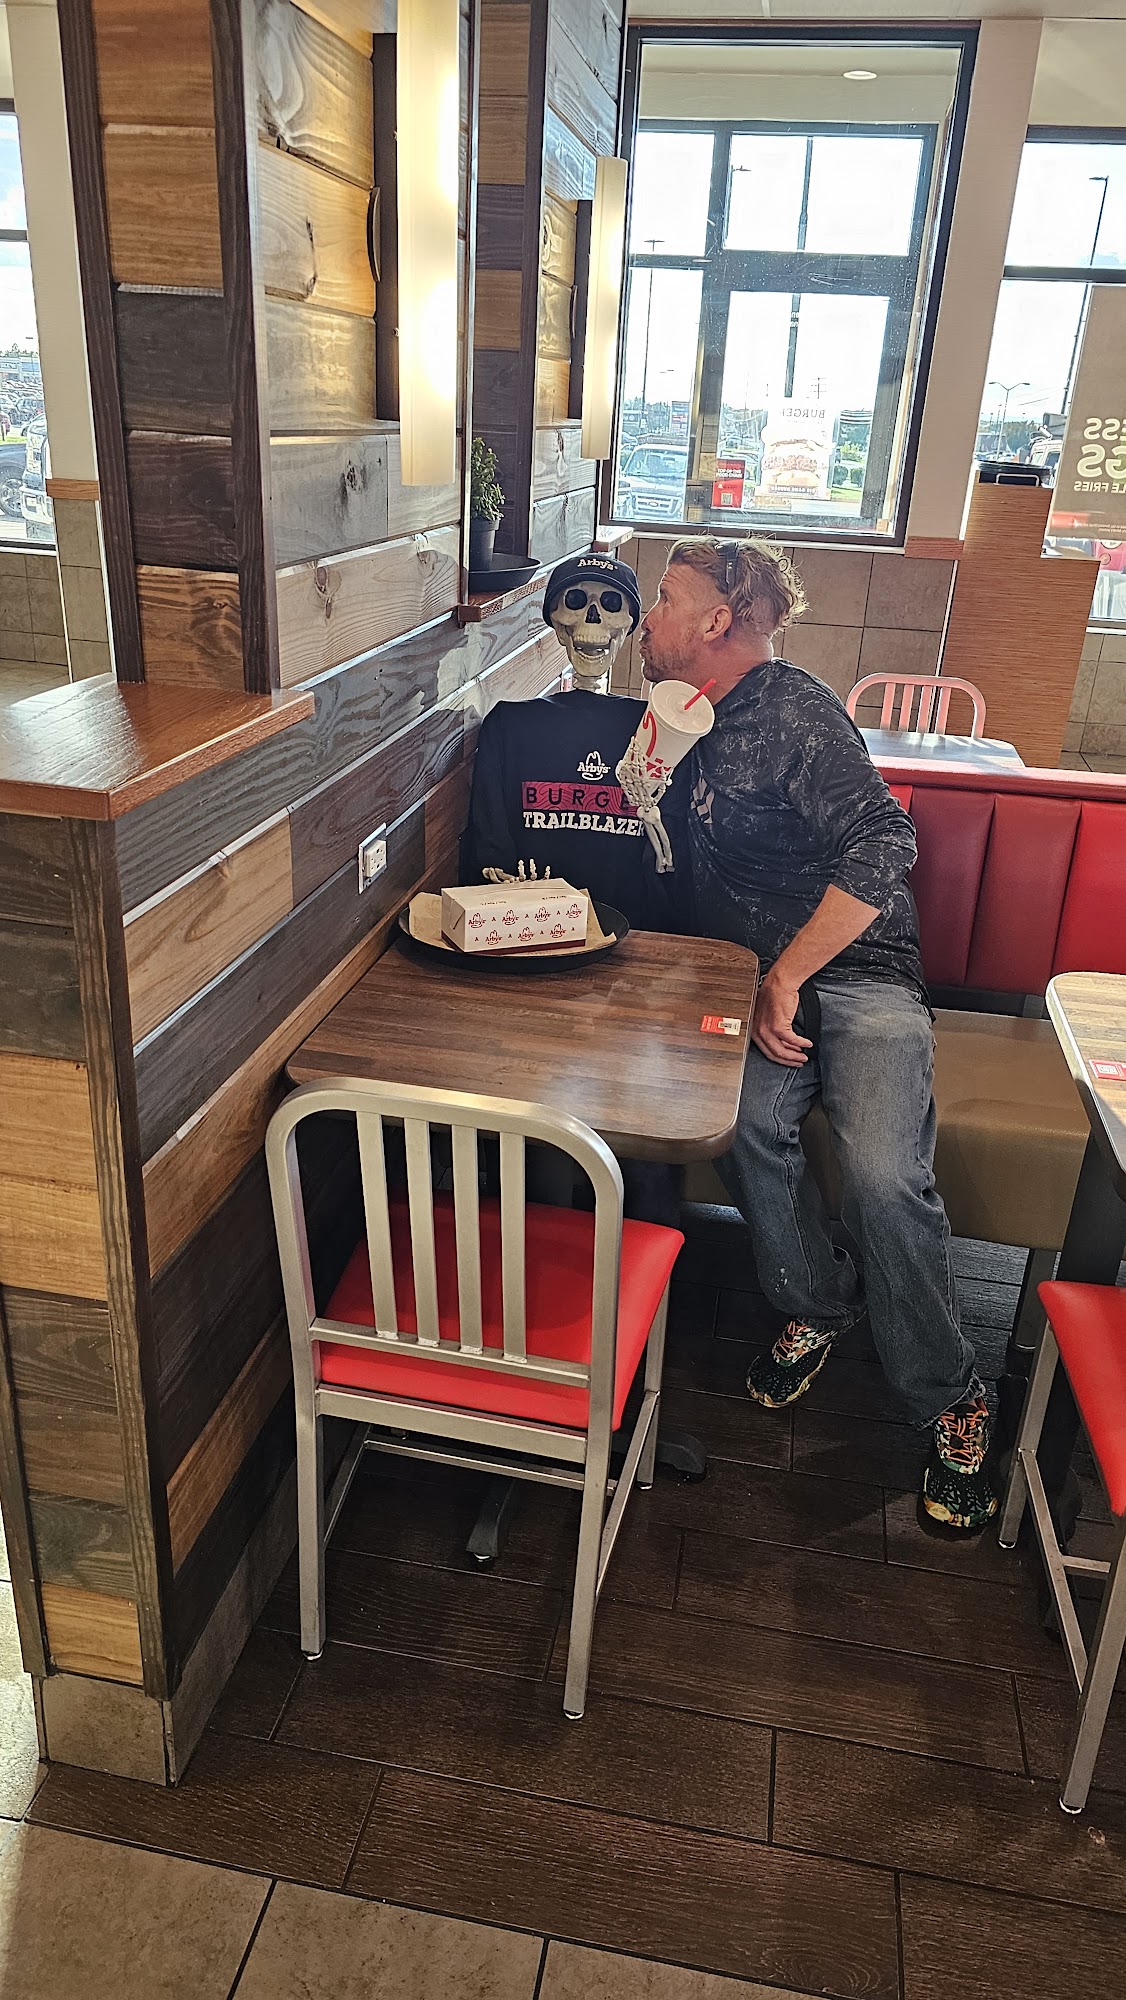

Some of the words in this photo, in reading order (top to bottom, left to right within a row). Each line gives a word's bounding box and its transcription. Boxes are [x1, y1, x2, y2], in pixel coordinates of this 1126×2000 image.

[577, 558, 615, 571] Arby's
[576, 762, 611, 775] Arby's
[525, 786, 631, 811] BURGE
